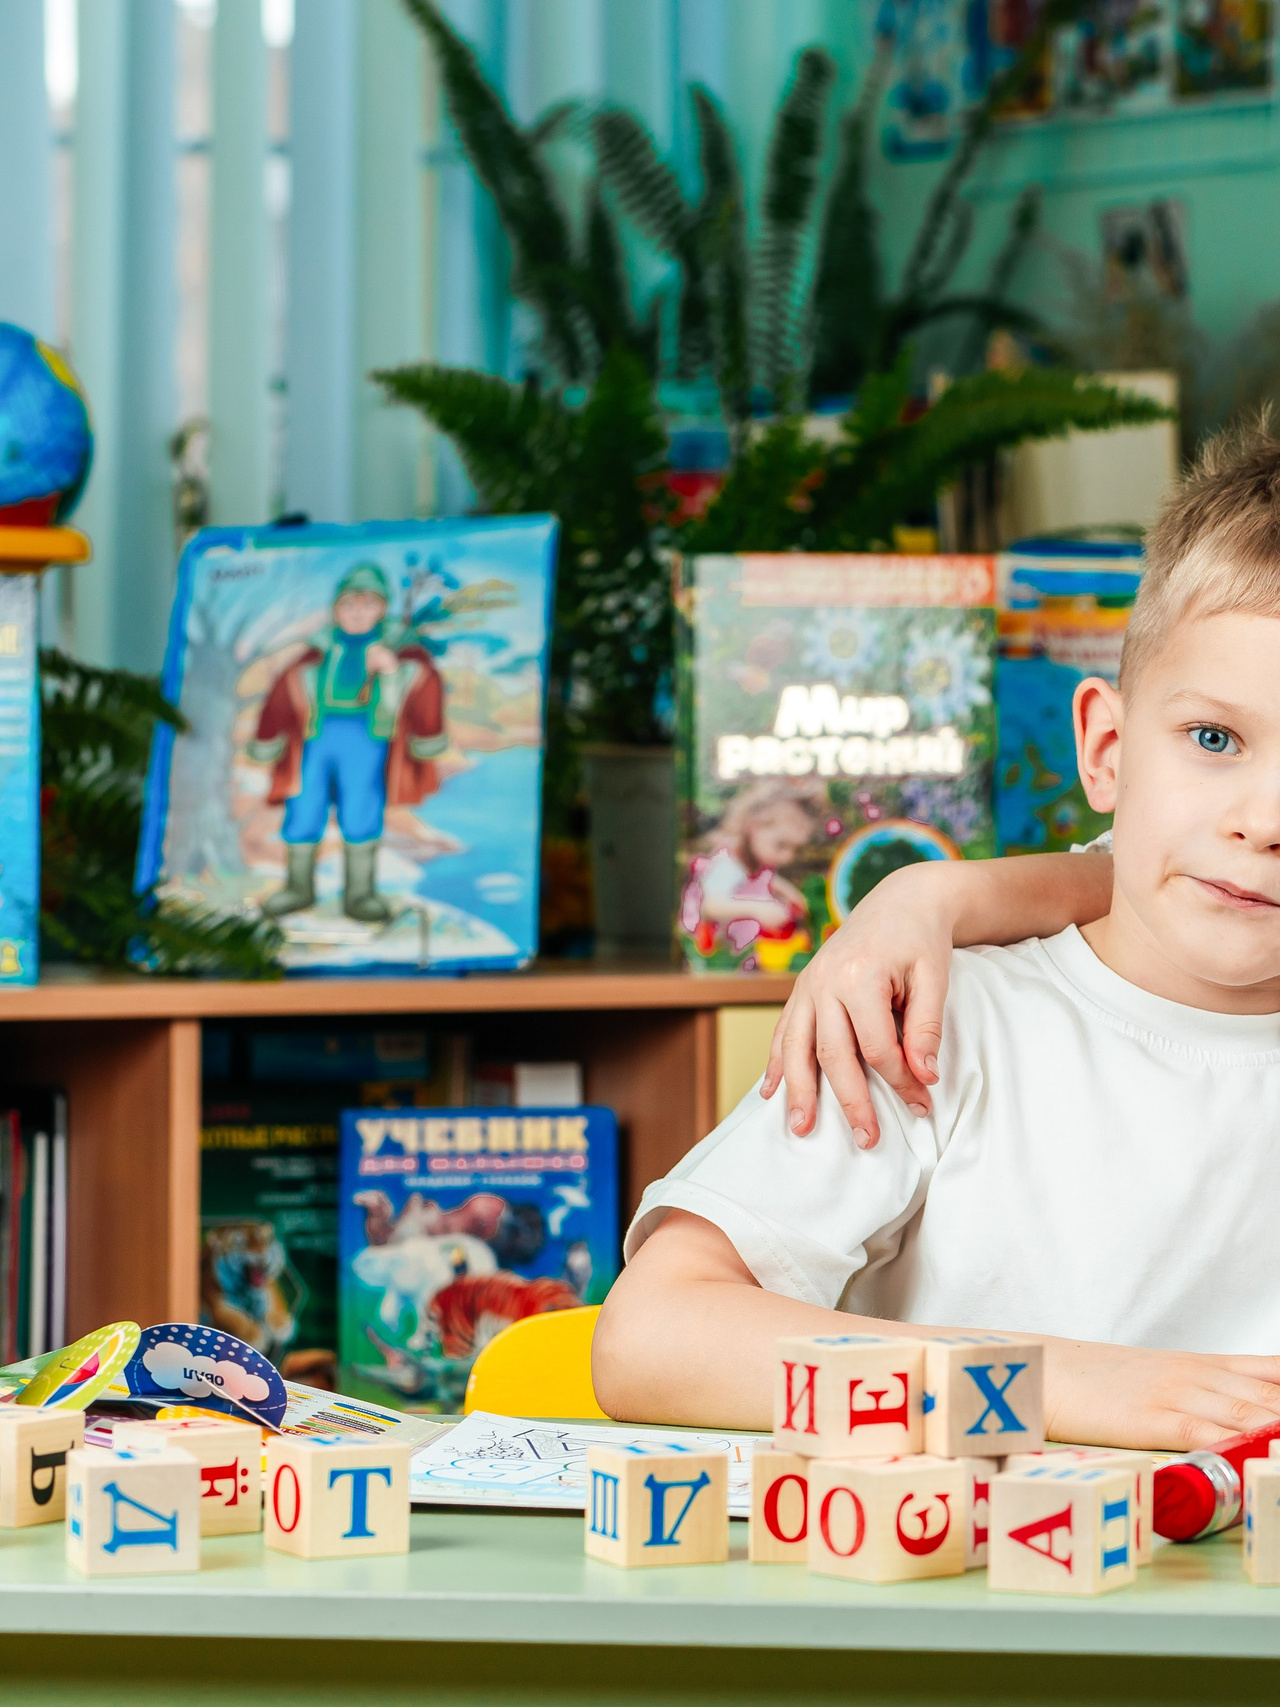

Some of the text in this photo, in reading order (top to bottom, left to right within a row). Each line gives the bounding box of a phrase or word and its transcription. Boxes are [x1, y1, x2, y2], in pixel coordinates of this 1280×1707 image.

[183, 1367, 225, 1387] ОВАЛ
[782, 1361, 819, 1435] И
[849, 1372, 909, 1436] Е
[963, 1363, 1028, 1435] Х
[102, 1480, 178, 1554] Д
[328, 1466, 393, 1540] Т
[1008, 1502, 1073, 1575] А
